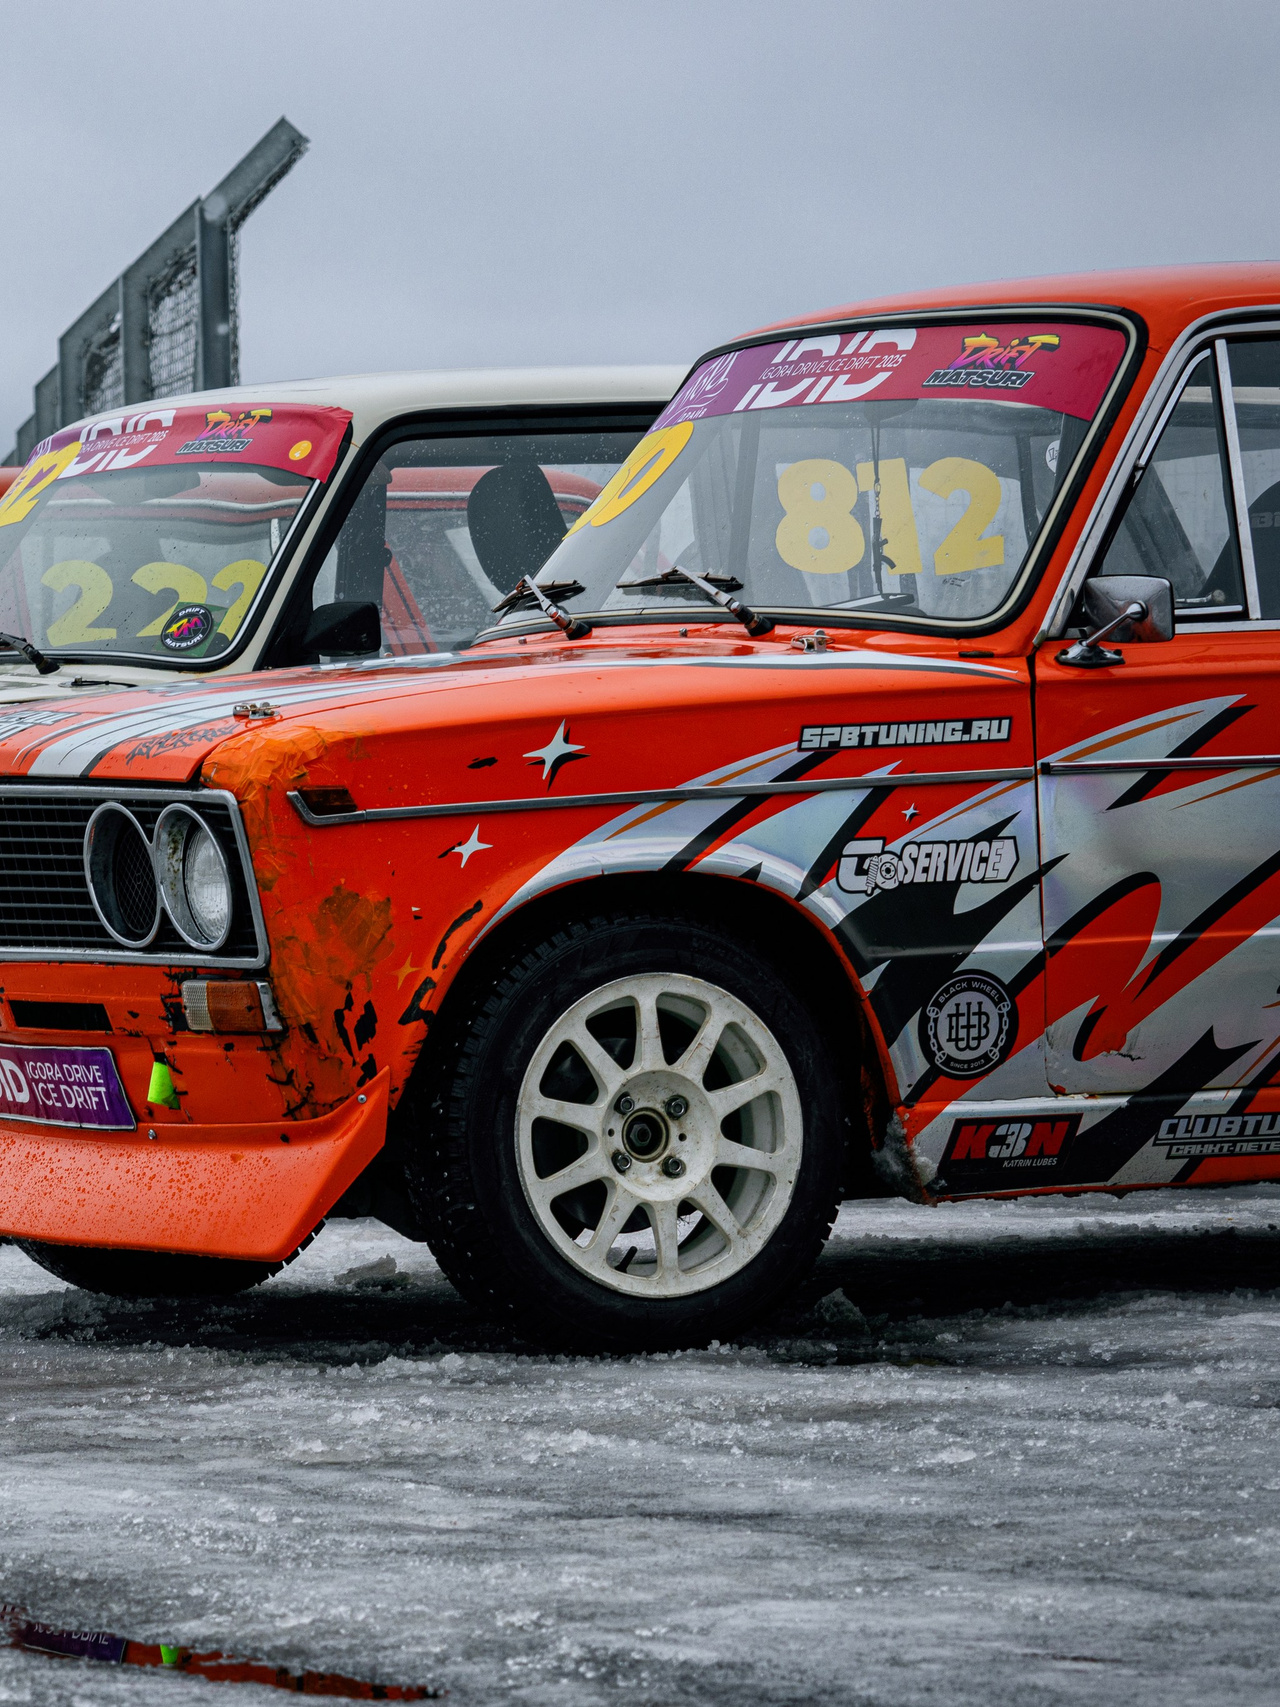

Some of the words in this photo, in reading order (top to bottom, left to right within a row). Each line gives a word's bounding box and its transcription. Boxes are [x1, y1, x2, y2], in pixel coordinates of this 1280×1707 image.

[758, 361, 793, 380] IGORA
[791, 360, 827, 376] DRIVE
[825, 357, 846, 372] ICE
[843, 355, 880, 371] DRIFT
[876, 353, 907, 369] 2025
[921, 369, 1036, 390] MATSURI
[175, 439, 254, 456] MATSURI
[775, 457, 1005, 576] 812
[178, 606, 206, 617] DRIFT
[165, 633, 204, 648] MATSURI
[800, 718, 1011, 749] SPBTUNING.RU
[938, 981, 968, 1003] BLACK
[971, 980, 1001, 1002] WHEEL
[24, 1061, 65, 1082] IGORA
[62, 1064, 104, 1084] DRIVE
[949, 1060, 968, 1069] SINCE
[32, 1082, 63, 1107] ICE
[60, 1084, 109, 1111] DRIFT
[1002, 1159, 1032, 1168] KATRIN
[1032, 1157, 1058, 1167] LUBES
